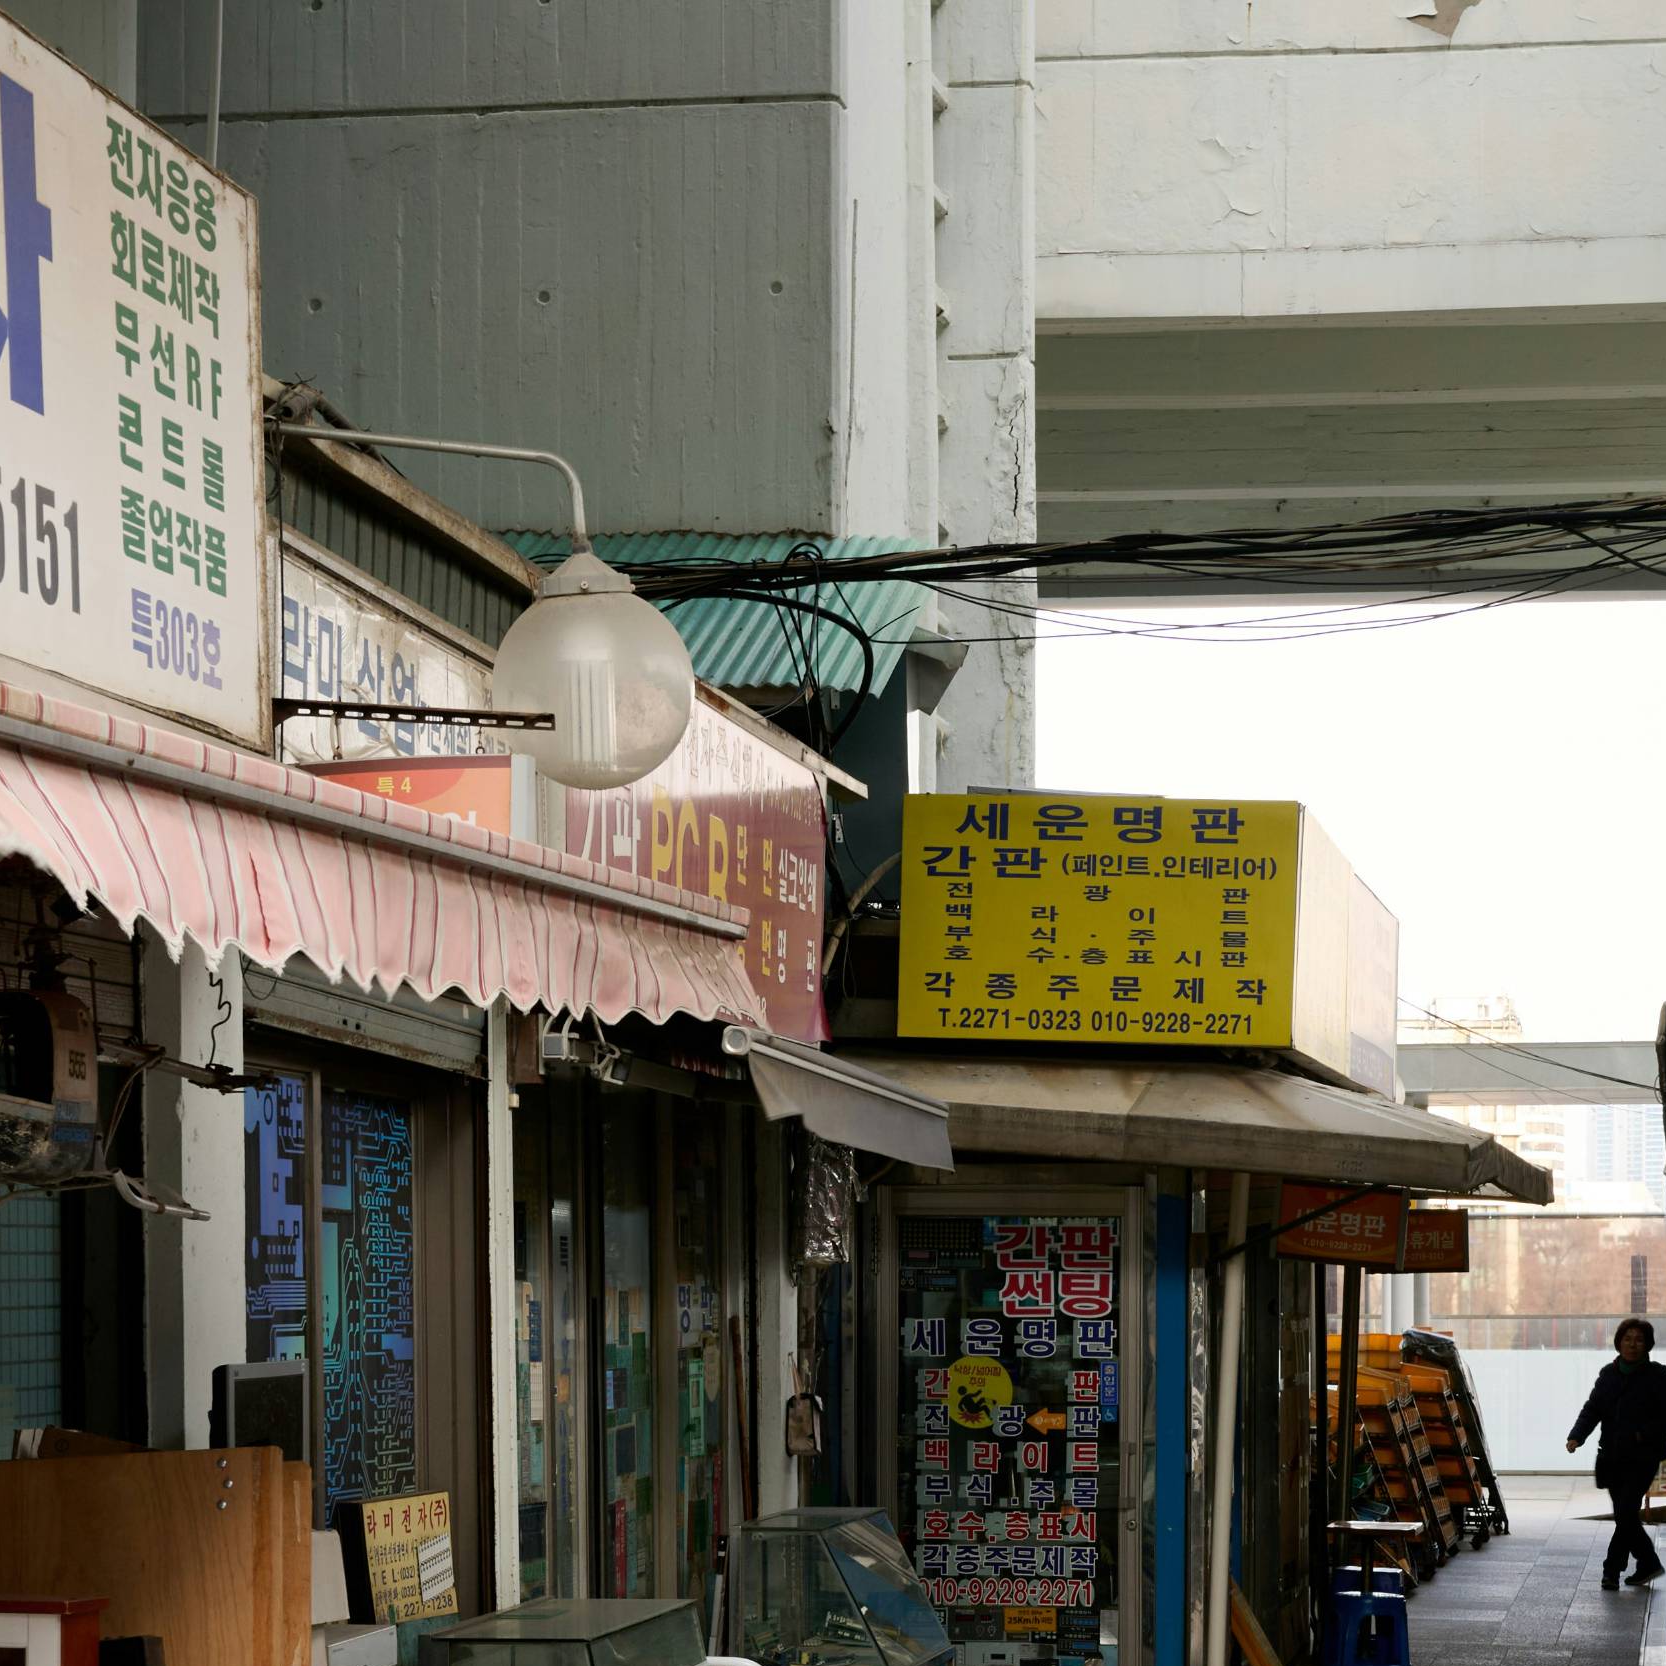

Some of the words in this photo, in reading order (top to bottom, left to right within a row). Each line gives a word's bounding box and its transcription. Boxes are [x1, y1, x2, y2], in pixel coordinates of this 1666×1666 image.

[106, 115, 217, 255] 전자응용
[110, 209, 221, 341] 회로제작
[120, 484, 228, 598] 졸업작품
[132, 588, 223, 691] 특303호
[376, 777, 394, 797] 특
[400, 777, 412, 793] 4
[956, 803, 1244, 844] 세운명판
[922, 846, 1047, 878] 간판
[938, 1007, 1081, 1032] T.2271-0323
[1091, 1011, 1252, 1036] 010-9228-2271
[995, 1223, 1118, 1271] 간판
[997, 1270, 1114, 1318] 썬팅
[911, 1319, 1117, 1358] 세운명판
[922, 1545, 1099, 1578] 각종주문제작
[919, 1578, 1093, 1606] 010-9228-2271
